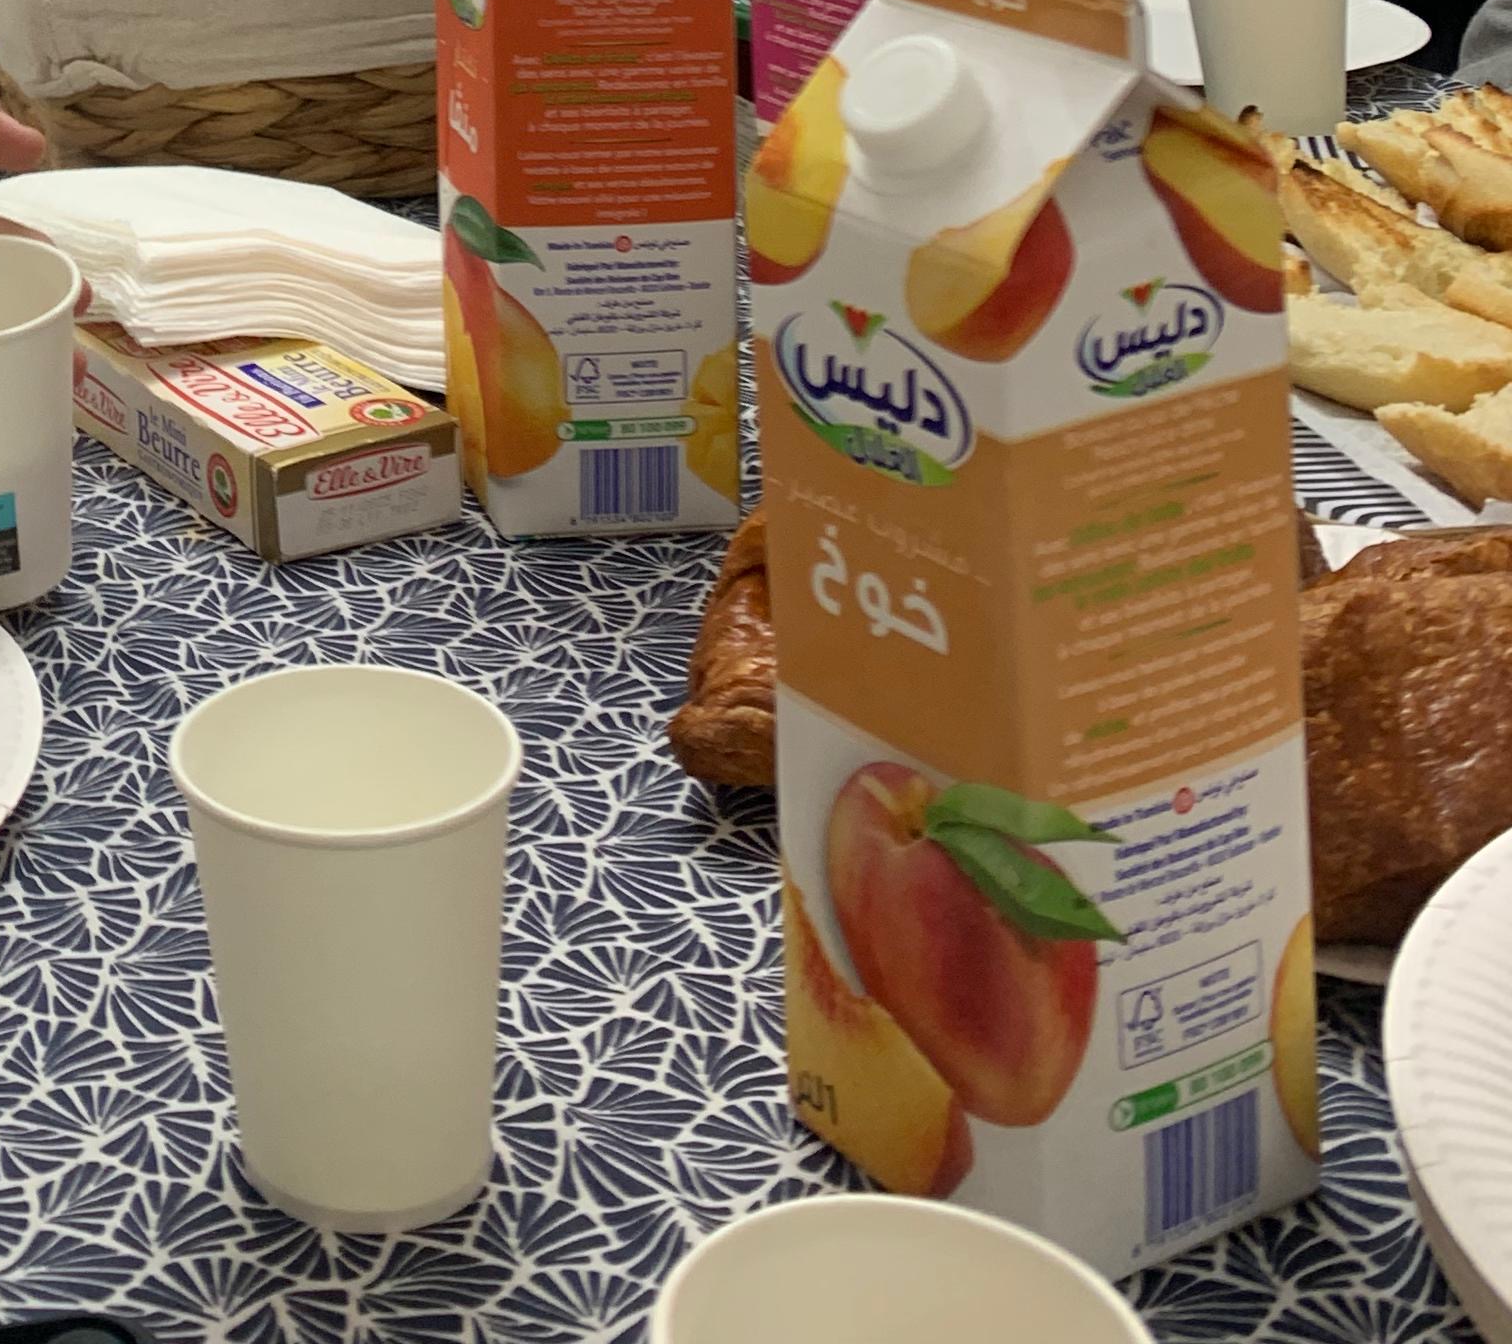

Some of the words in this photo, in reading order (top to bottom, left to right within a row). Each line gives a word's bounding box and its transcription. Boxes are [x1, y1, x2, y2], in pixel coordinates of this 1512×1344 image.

[1093, 302, 1208, 372] دليس
[169, 359, 231, 397] Vire
[222, 390, 251, 403] &
[283, 352, 373, 400] Beurre
[795, 342, 951, 438] دليس
[233, 401, 306, 439] Elle
[136, 409, 202, 482] Beurre
[314, 465, 359, 495] Elle
[363, 468, 379, 483] &
[380, 455, 424, 479] Vire
[810, 523, 949, 655] خوخ
